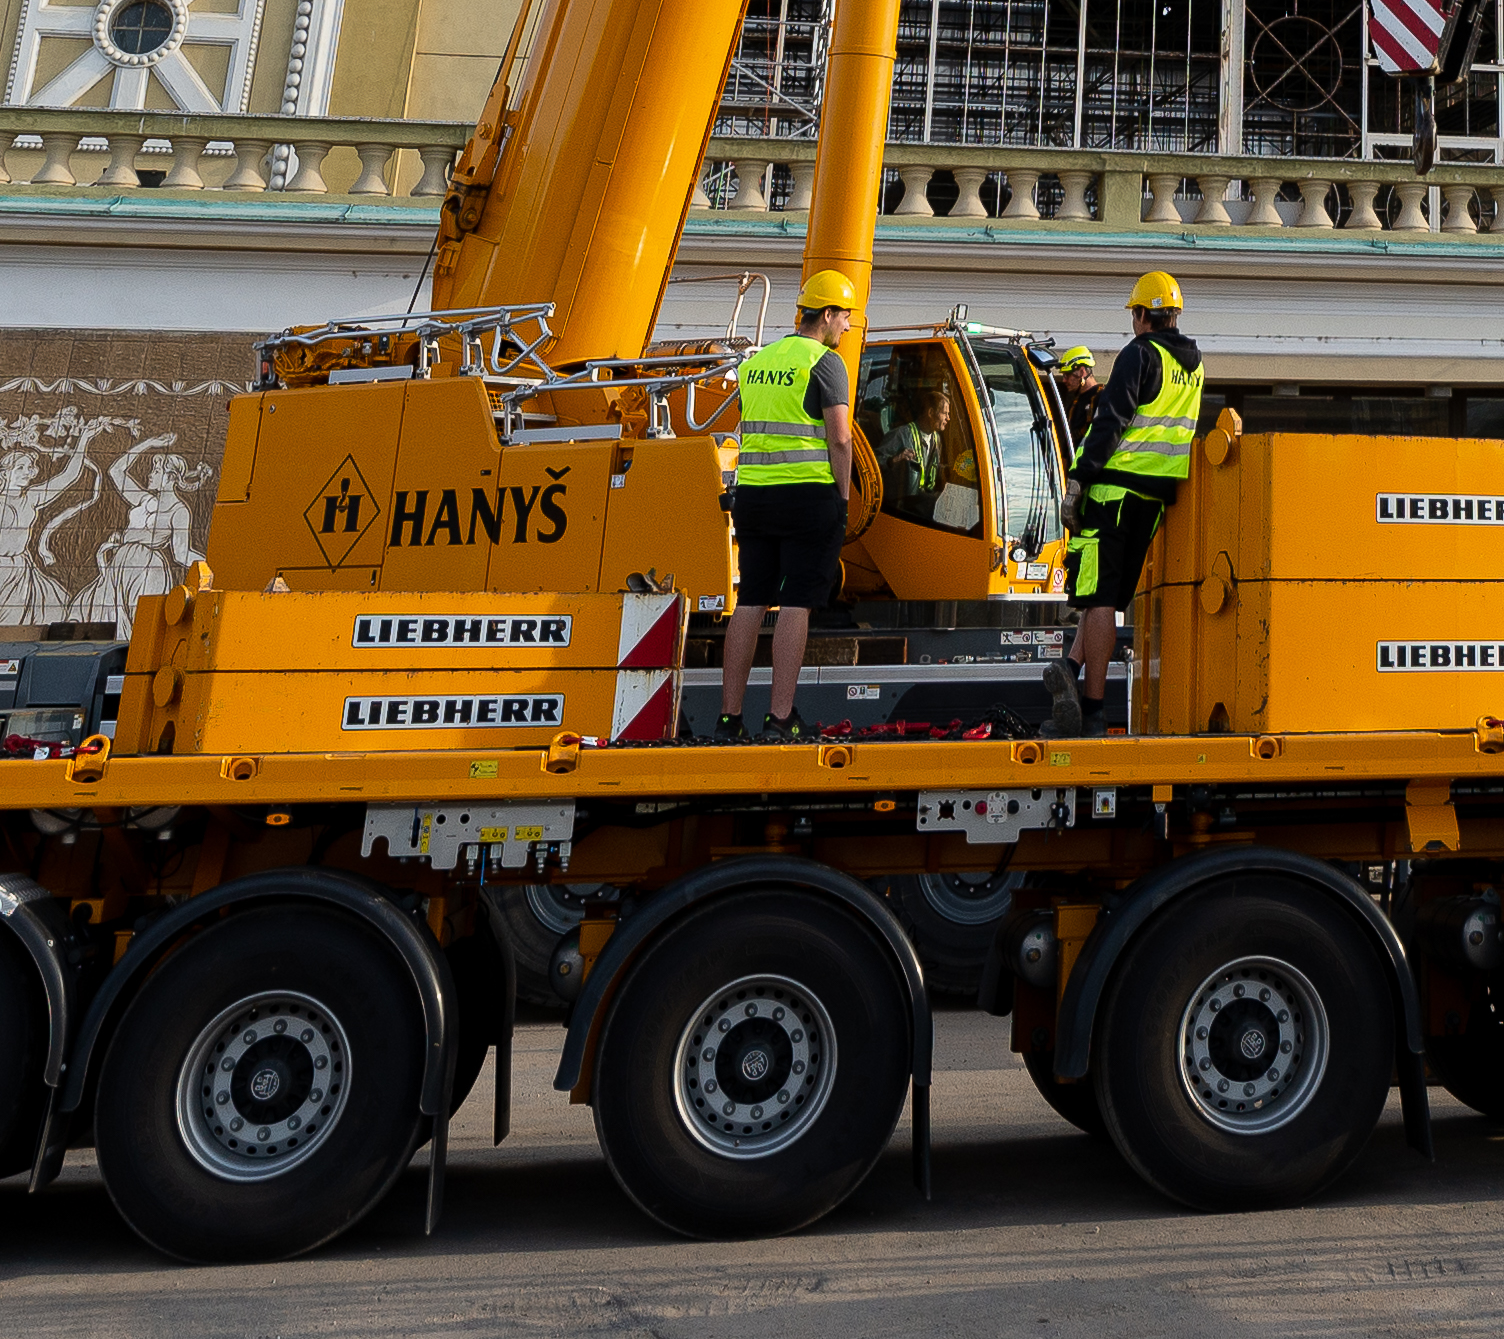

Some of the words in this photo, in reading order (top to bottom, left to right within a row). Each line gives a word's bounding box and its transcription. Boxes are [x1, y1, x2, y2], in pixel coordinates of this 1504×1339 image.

[747, 367, 797, 386] HANYŠ
[388, 465, 571, 547] HANYŠ
[357, 619, 567, 643] LIEBHERR
[346, 698, 559, 726] LIEBHERR
